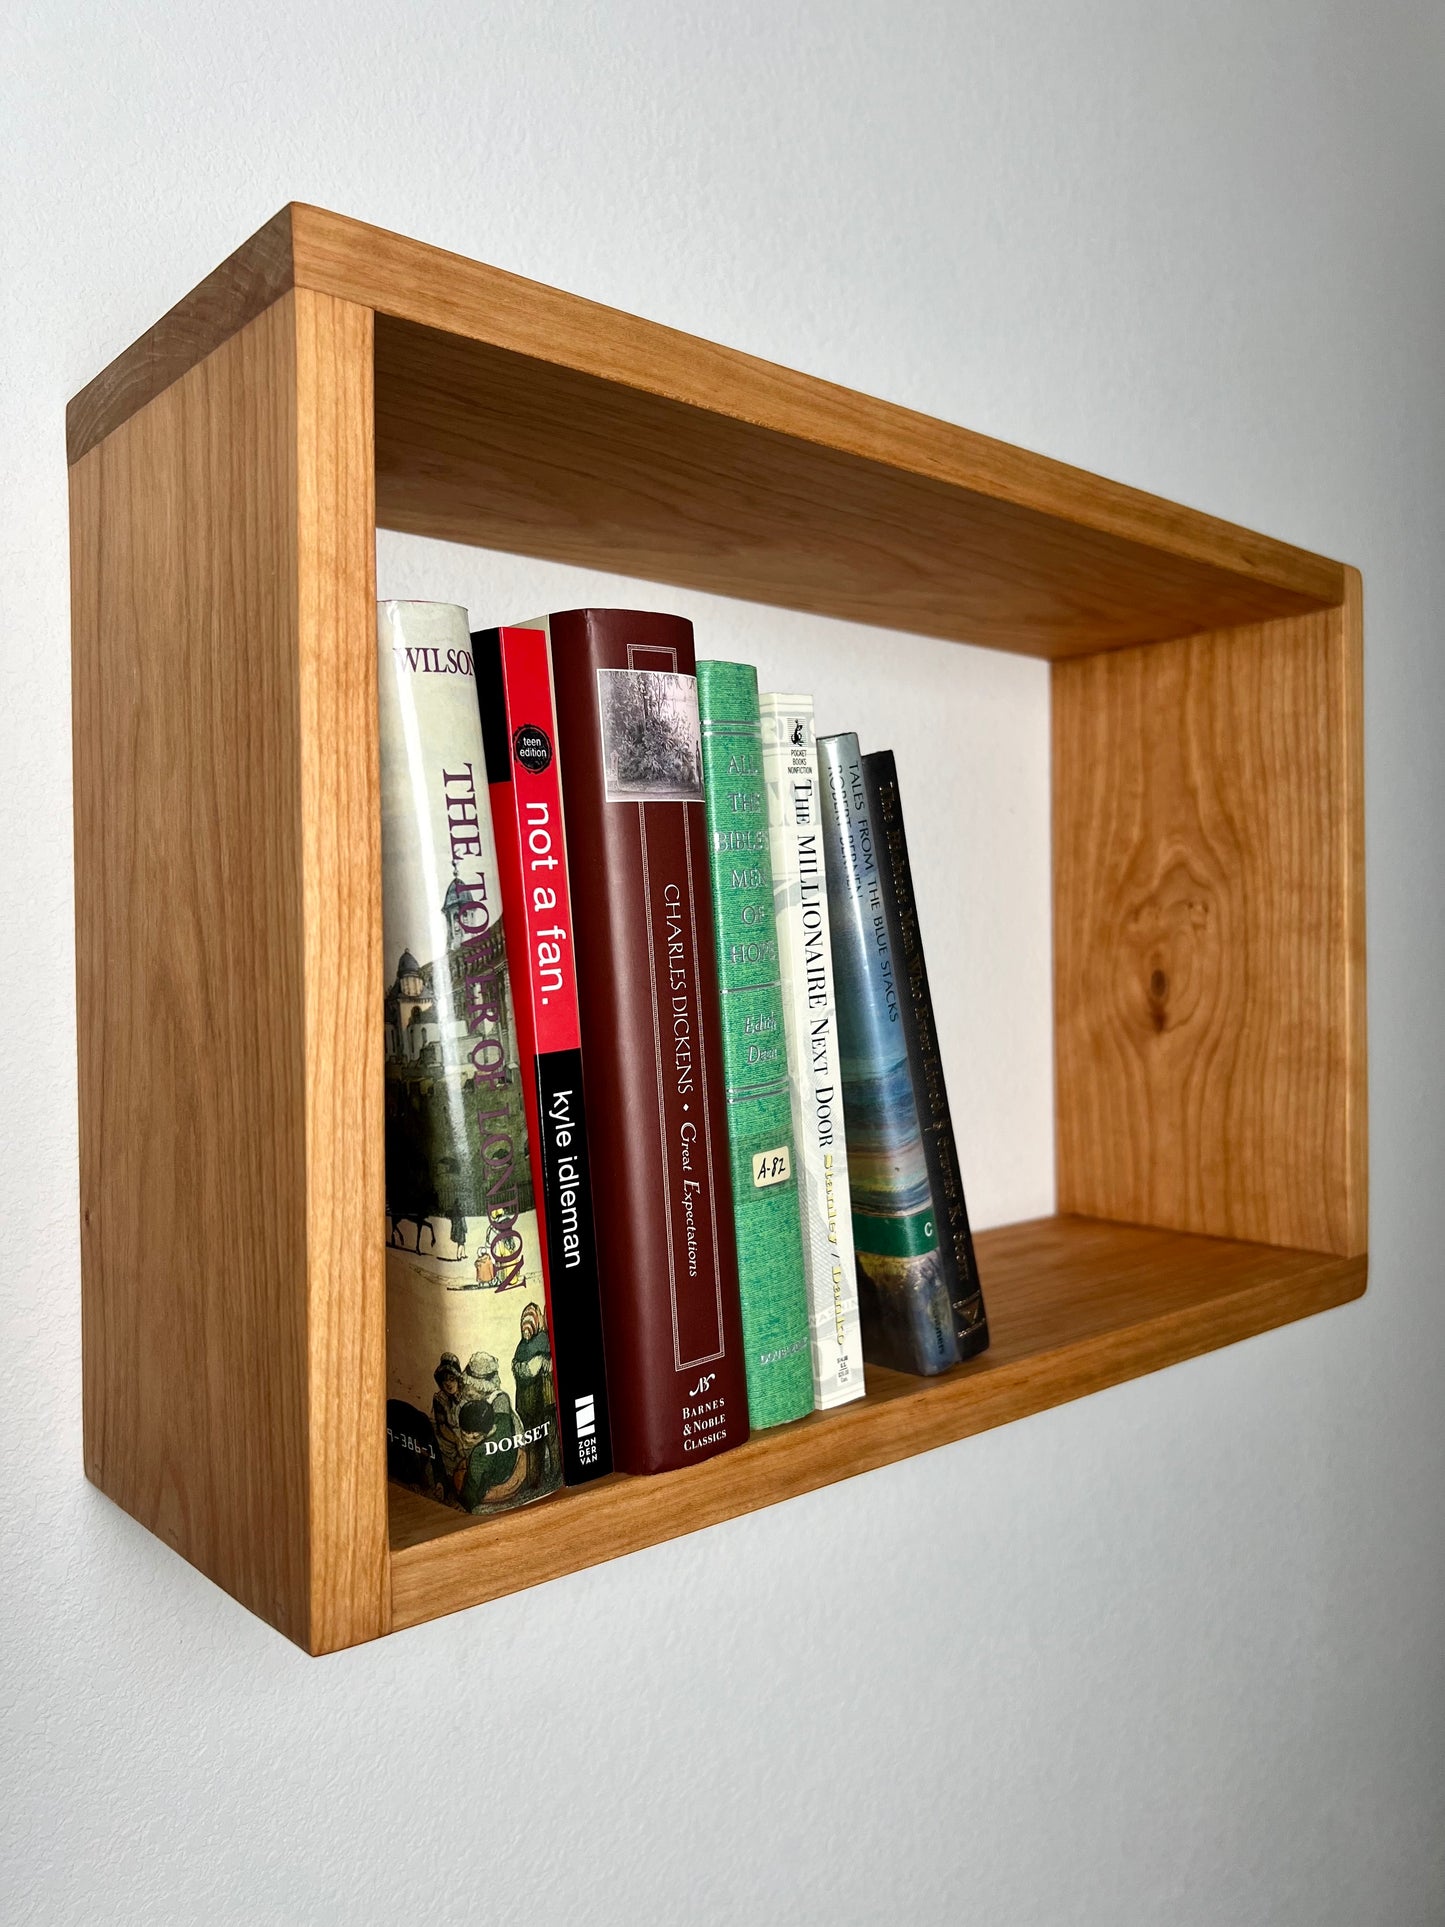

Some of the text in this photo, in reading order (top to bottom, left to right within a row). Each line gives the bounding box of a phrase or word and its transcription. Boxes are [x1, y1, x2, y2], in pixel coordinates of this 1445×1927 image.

[393, 647, 475, 676] WILSON
[519, 748, 547, 757] edition
[523, 737, 541, 746] teen
[791, 749, 807, 757] POCKET
[792, 758, 807, 766] BOOKS
[727, 755, 758, 777] ALL
[787, 766, 812, 774] NONFICTION
[727, 793, 762, 813] THE
[730, 867, 768, 888] MEN
[849, 760, 899, 1023] TALES FROM THE BLUE STACKS
[526, 802, 566, 1005] not a fan.
[742, 905, 765, 925] OF
[730, 942, 776, 963] HOPE
[794, 779, 834, 1148] THE MILLIONAIRE NEXT DOOR
[664, 883, 694, 1095] CHARLES DICKENS
[442, 762, 526, 1293] THE TOWER OF LONDON
[548, 1090, 581, 1269] kyle idleman
[757, 1157, 786, 1180] A-82
[680, 1122, 701, 1278] Great Expectations
[924, 1221, 933, 1237] C
[823, 1153, 837, 1245] Stanley
[832, 1264, 844, 1346] Danko
[682, 1397, 725, 1420] BARNES
[484, 1421, 551, 1456] DORSET
[578, 1437, 597, 1449] ZON
[684, 1429, 727, 1451] CLASSICS
[579, 1445, 597, 1458] DER
[580, 1453, 598, 1465] VAN
